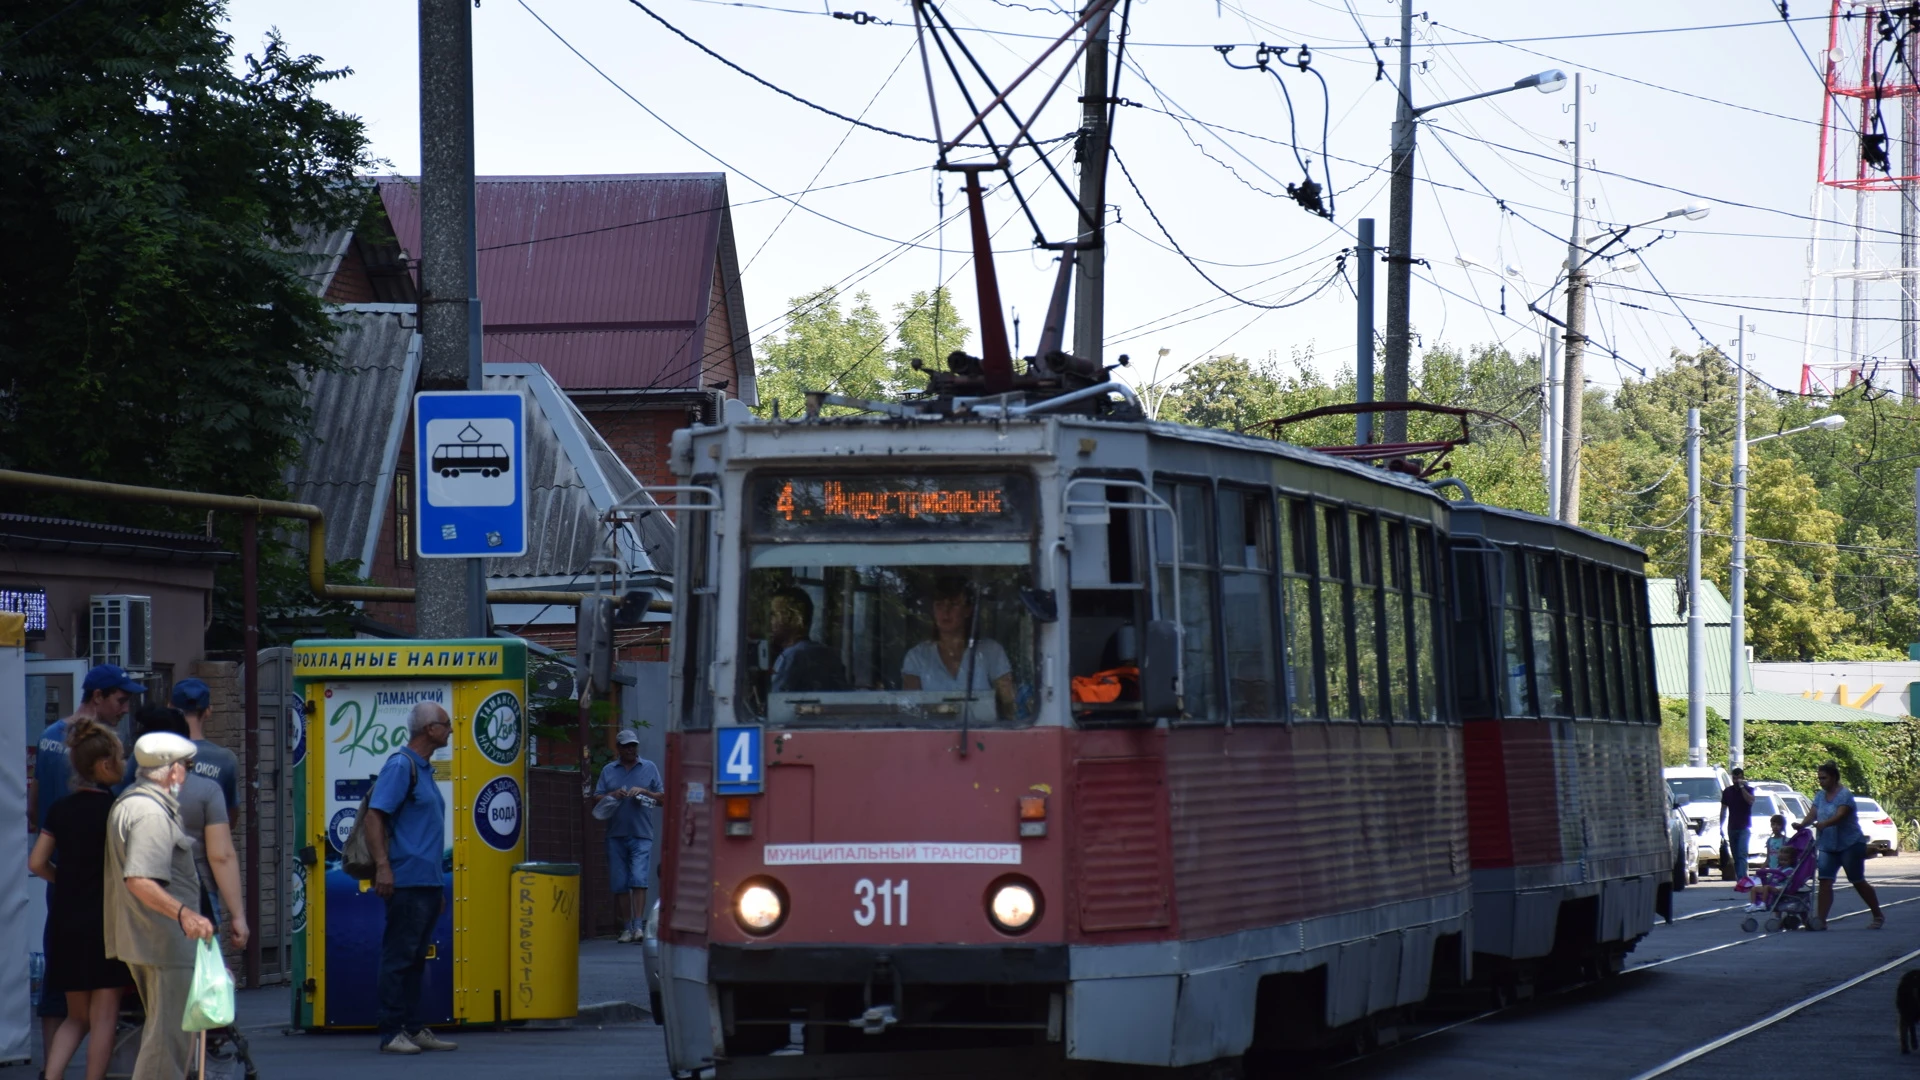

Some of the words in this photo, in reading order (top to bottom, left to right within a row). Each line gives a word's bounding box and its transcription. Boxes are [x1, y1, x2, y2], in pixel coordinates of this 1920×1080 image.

[407, 651, 498, 667] НАПИТКИ
[376, 689, 443, 705] ТАМАНСКИЙ
[726, 731, 753, 782] 4
[195, 762, 221, 778] ОКОН
[477, 787, 495, 814] ВАШЕ
[491, 806, 516, 823] ВОДА
[766, 844, 917, 863] МУНИЦИПАЛЬНЫЙ
[923, 847, 1020, 861] ТРАНСПОРТ
[853, 878, 909, 927] 311
